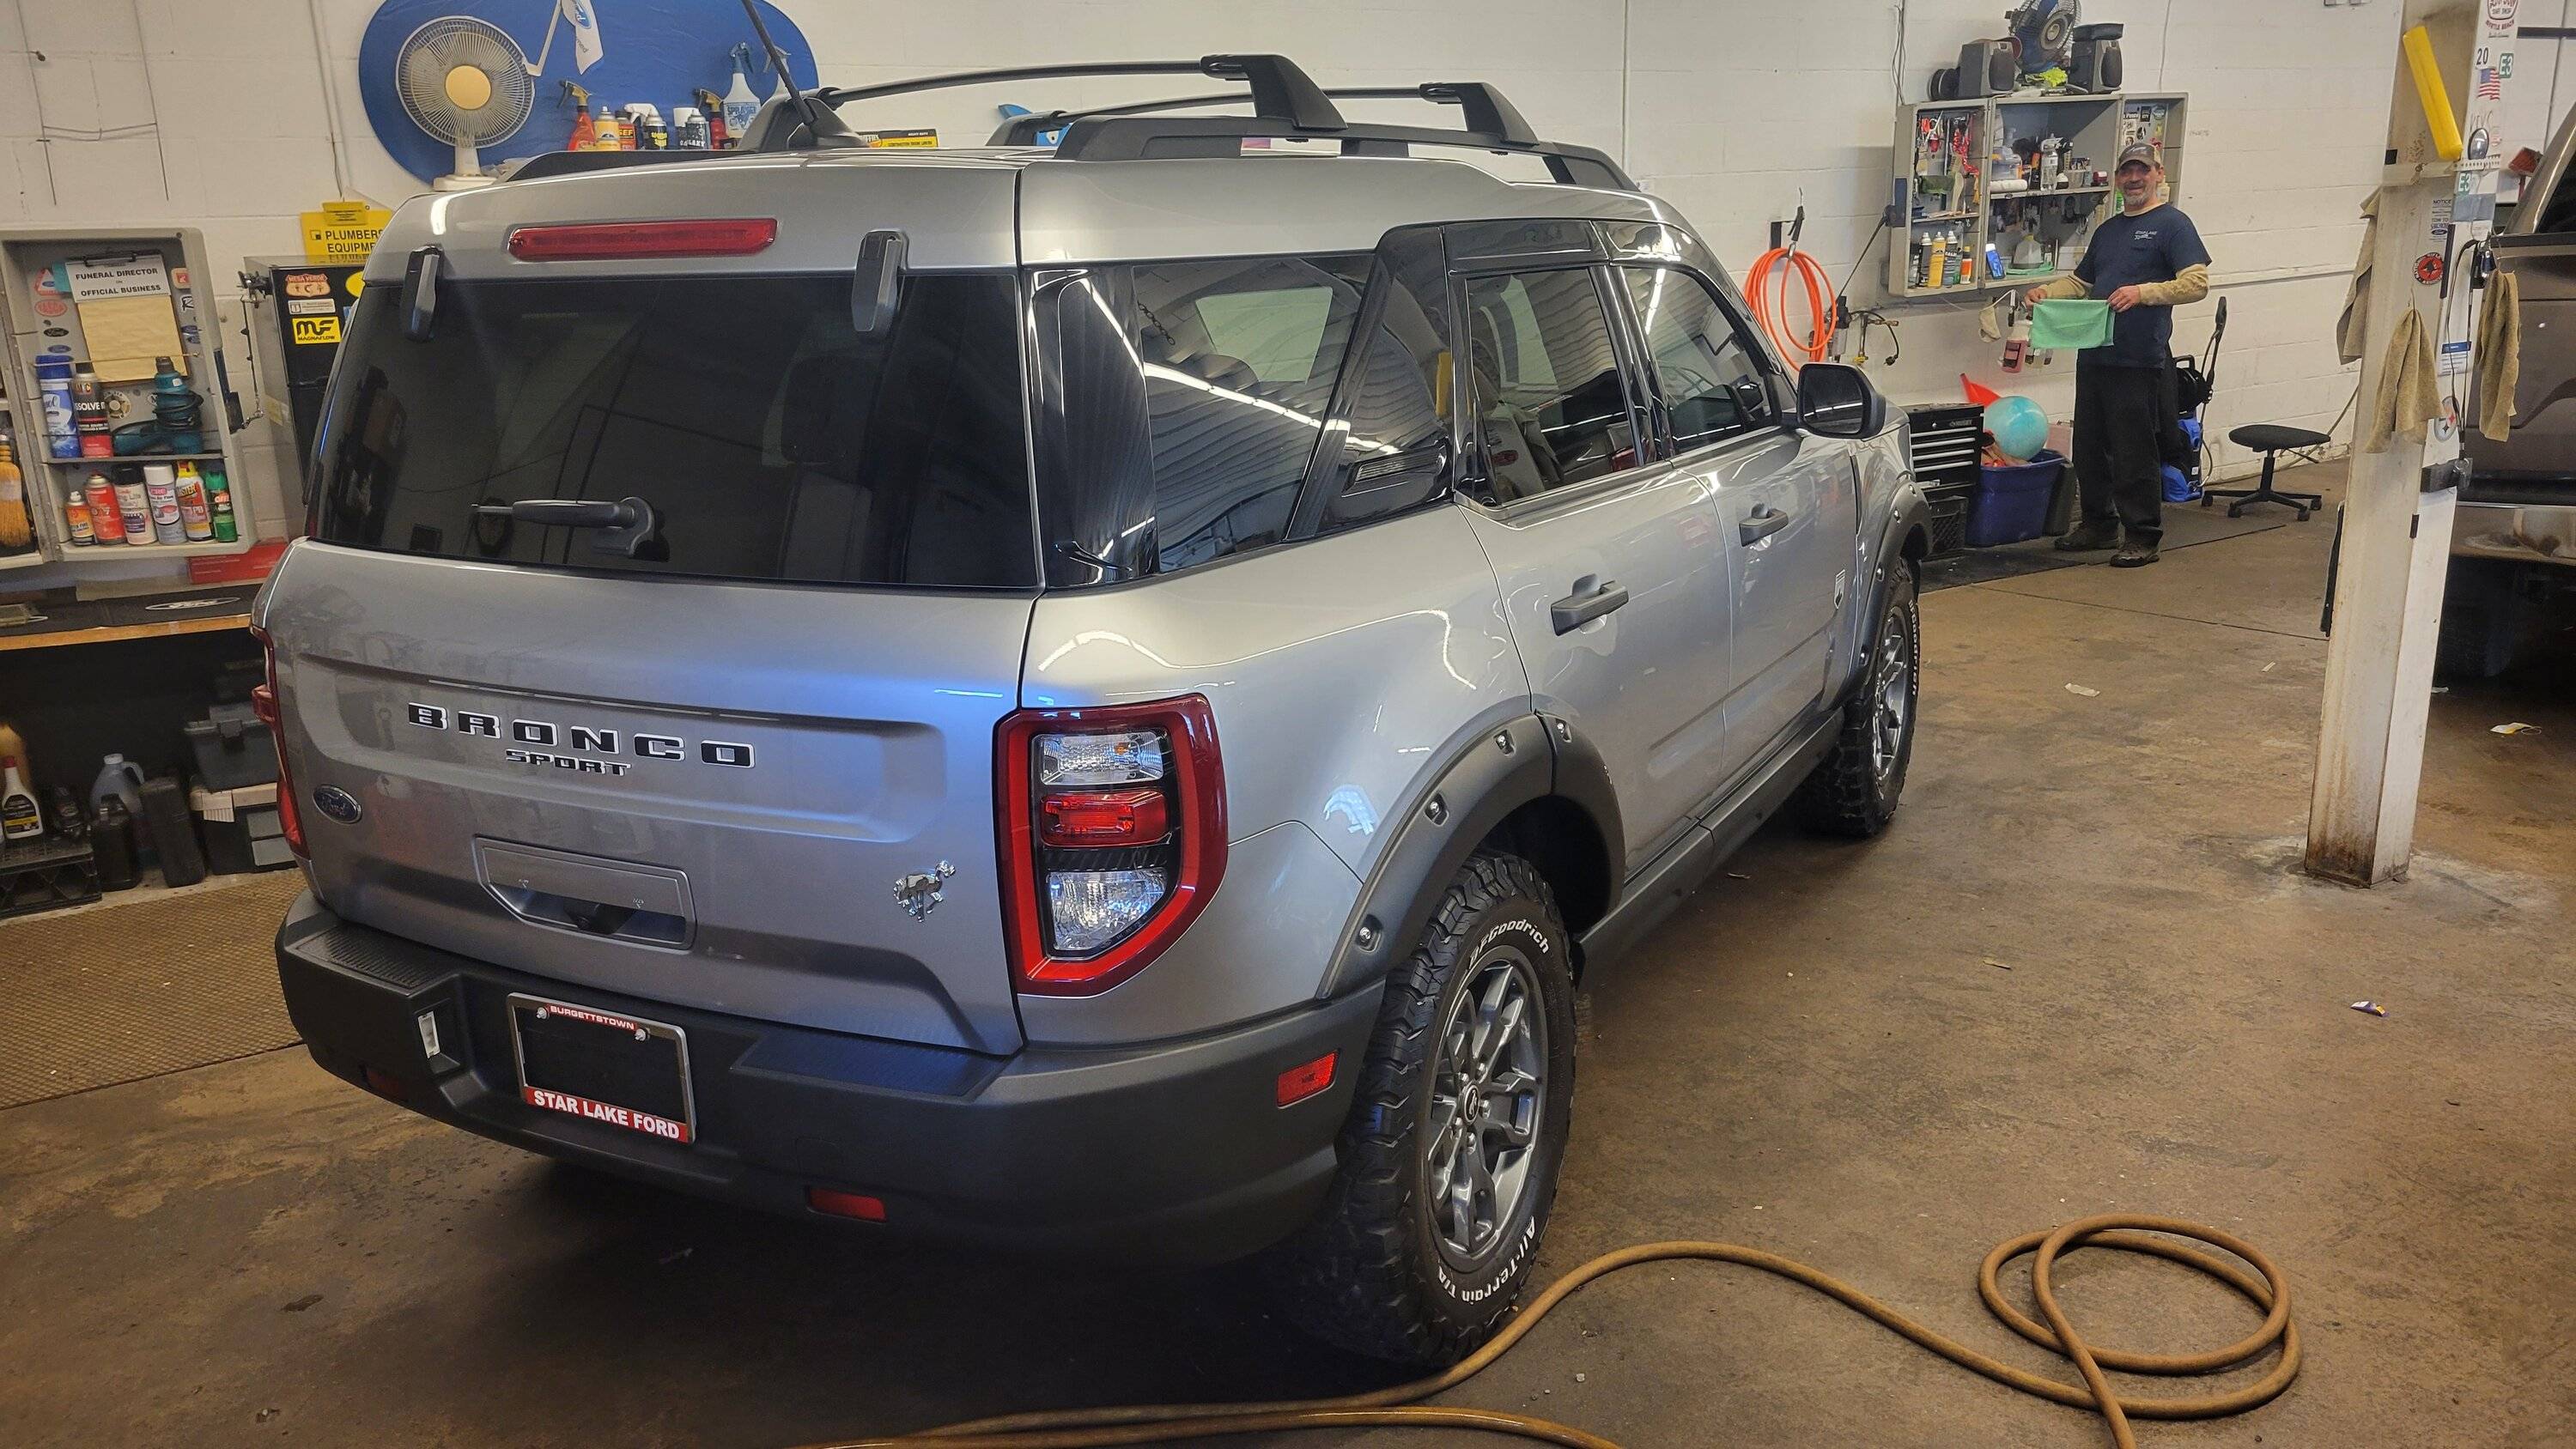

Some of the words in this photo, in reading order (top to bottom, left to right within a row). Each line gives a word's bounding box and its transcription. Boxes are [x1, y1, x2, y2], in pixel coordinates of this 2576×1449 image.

[2476, 47, 2488, 65] 20
[2500, 55, 2512, 76] E3
[76, 270, 114, 280] FUNERAL
[117, 267, 158, 277] DIRECTOR
[81, 286, 118, 297] OFFICIAL
[120, 284, 161, 294] BUSINESS
[408, 701, 756, 768] BRONCO
[506, 748, 631, 776] SPORT
[1469, 919, 1549, 970] BFGoodrich
[550, 1005, 635, 1030] BURGETTSTOWN
[534, 1090, 580, 1114] STAR
[583, 1100, 629, 1126] LAKE
[633, 1113, 680, 1140] FORD
